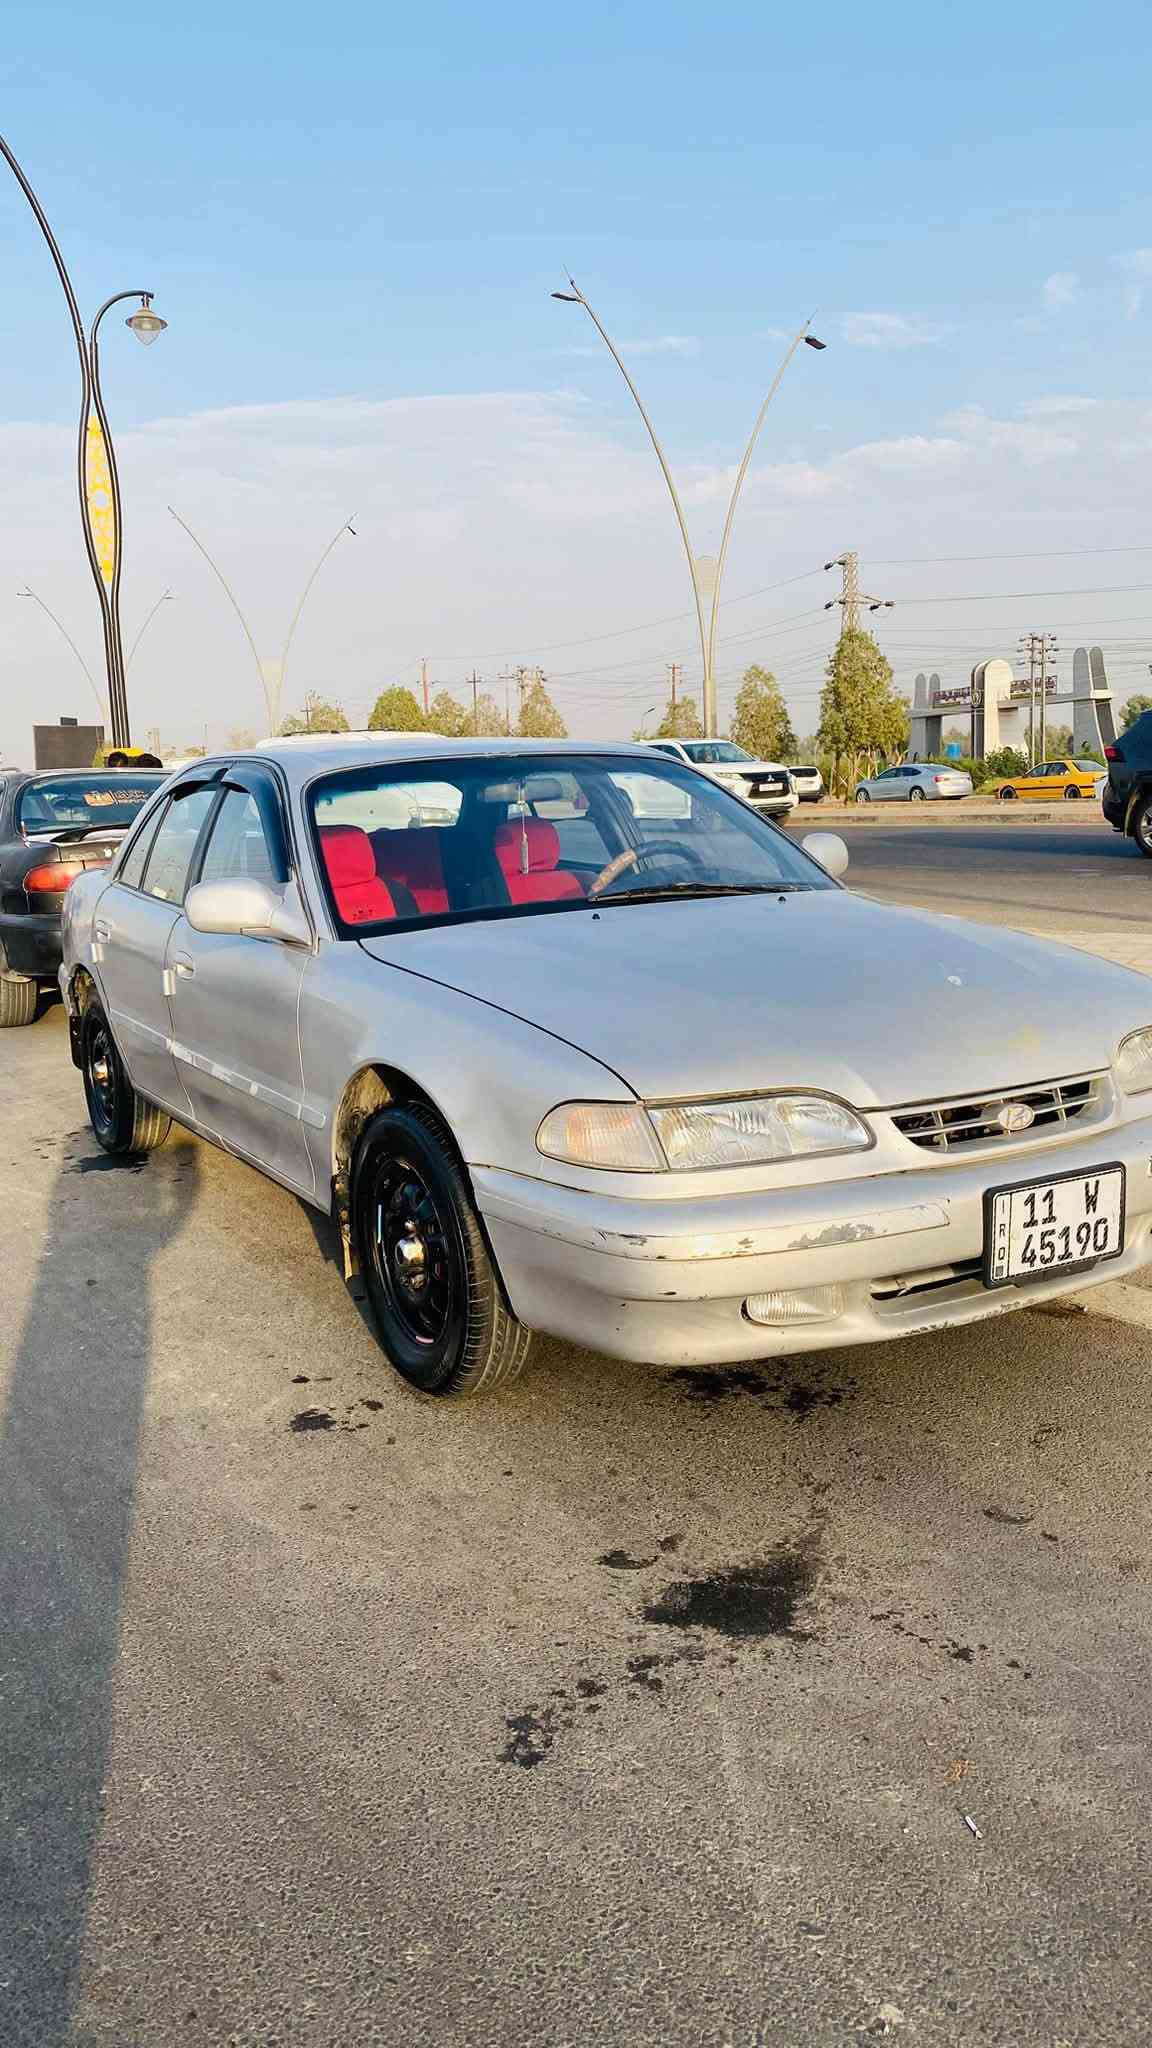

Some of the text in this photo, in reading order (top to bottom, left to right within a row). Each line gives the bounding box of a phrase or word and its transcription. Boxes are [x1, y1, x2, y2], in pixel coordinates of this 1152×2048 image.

[1023, 1179, 1100, 1229] 11 W
[1021, 1217, 1108, 1267] 45190
